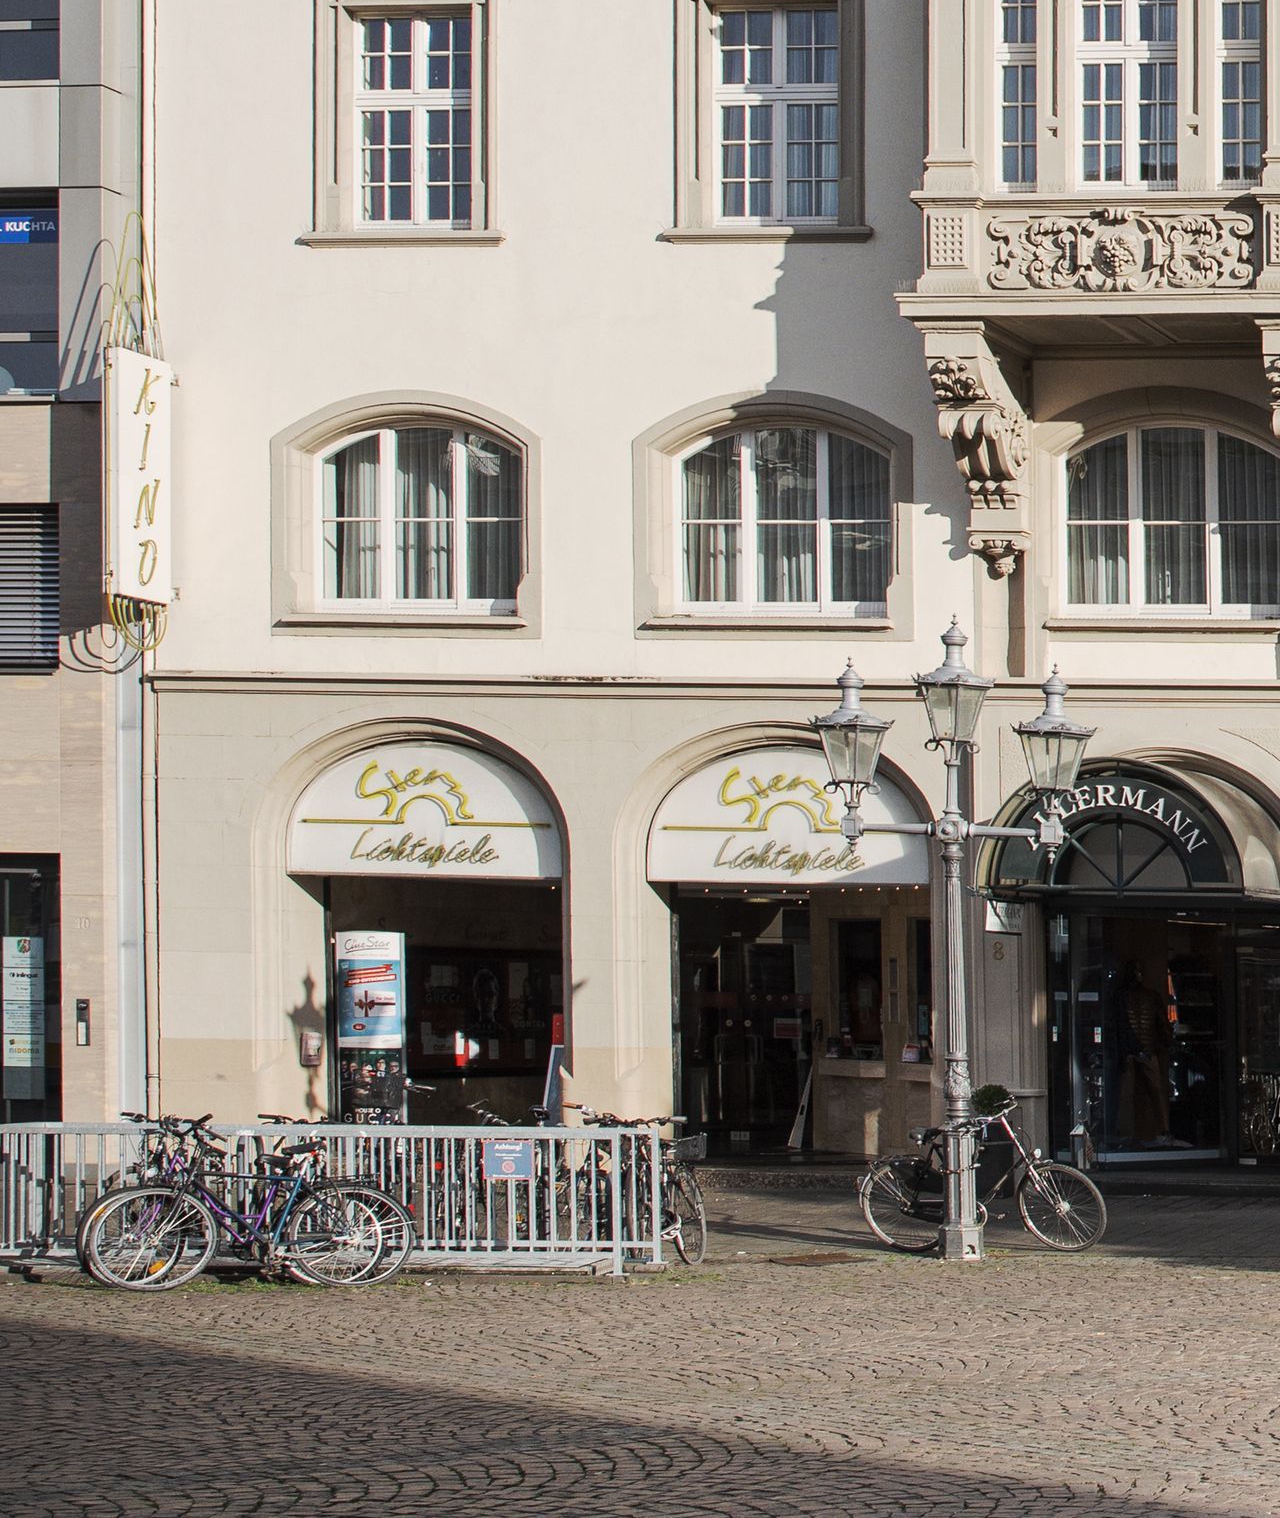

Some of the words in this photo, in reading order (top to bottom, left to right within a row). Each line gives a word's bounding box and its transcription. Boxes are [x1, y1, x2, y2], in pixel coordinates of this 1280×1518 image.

[5, 221, 56, 232] KUCHTA
[133, 367, 162, 587] KINO
[355, 759, 475, 820] Stern
[717, 765, 840, 825] Stern
[1026, 784, 1208, 854] LERMANN
[350, 827, 500, 869] Lichtspiele
[713, 834, 866, 877] Lichtspiele
[993, 941, 1005, 961] 8
